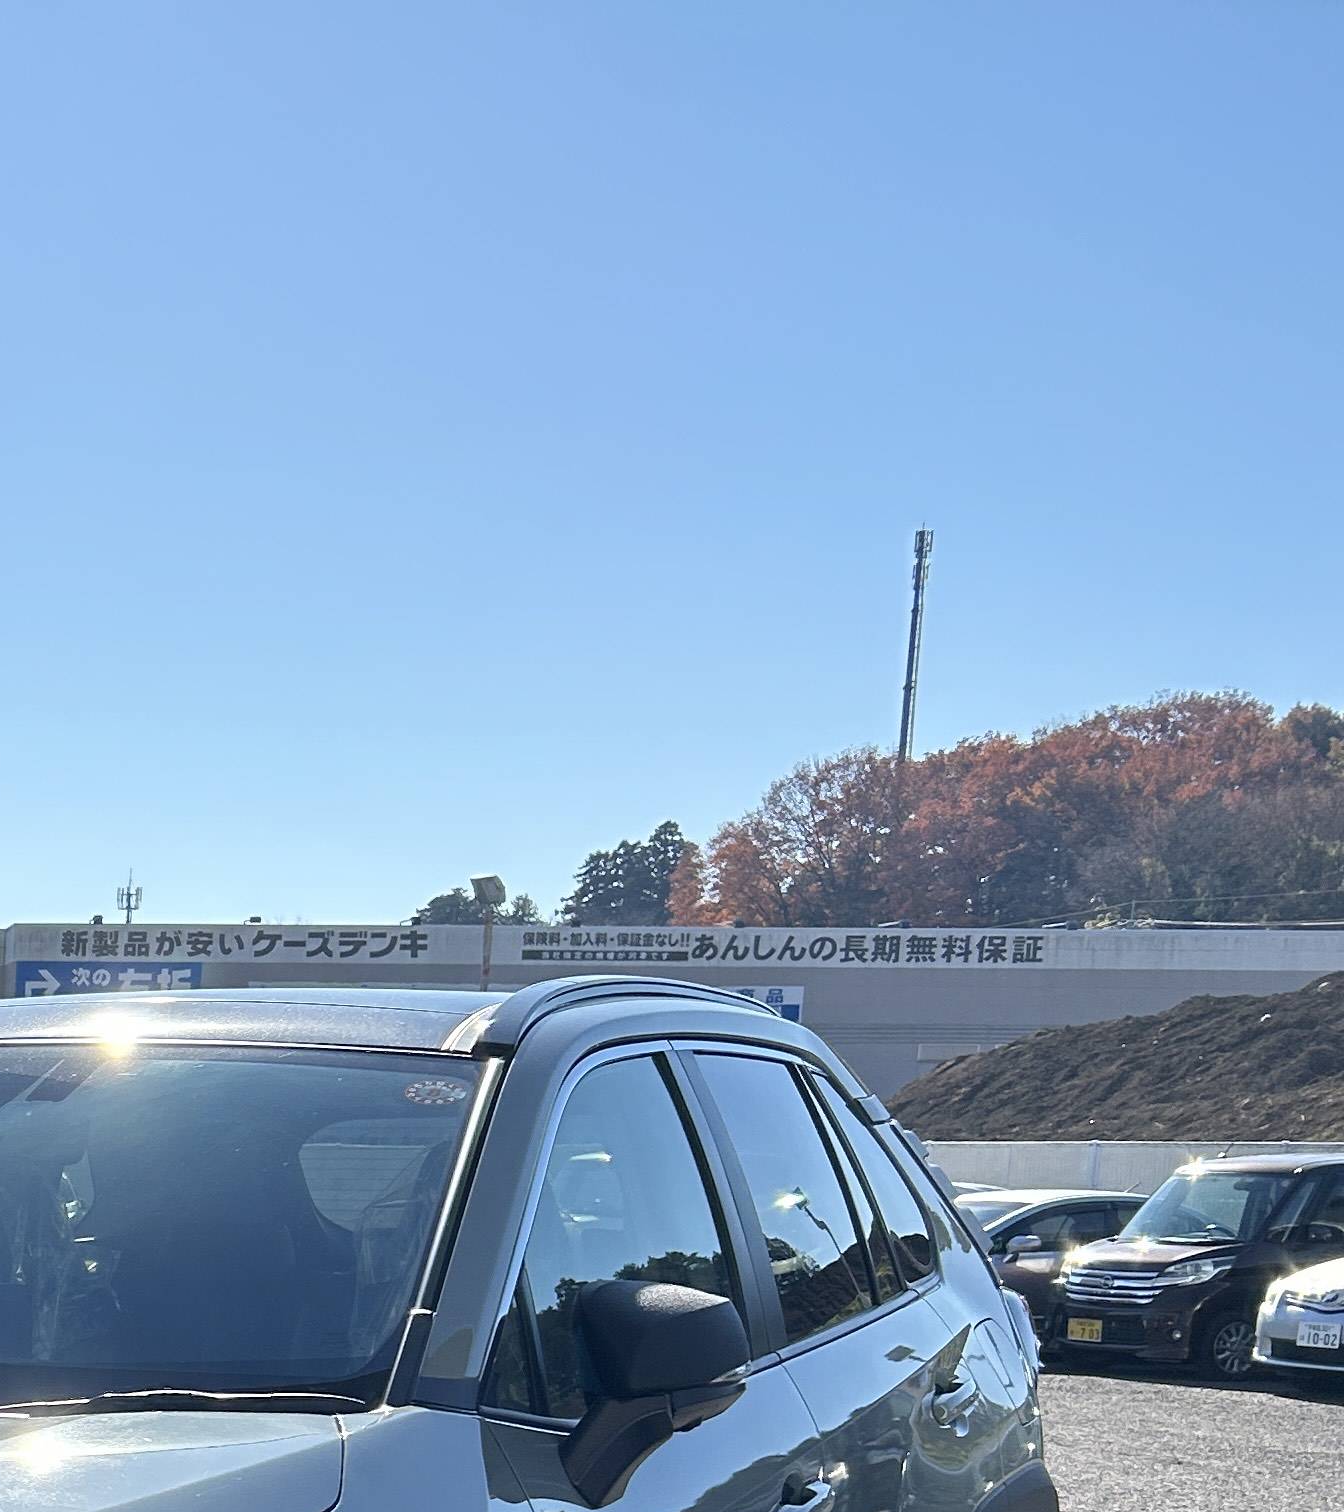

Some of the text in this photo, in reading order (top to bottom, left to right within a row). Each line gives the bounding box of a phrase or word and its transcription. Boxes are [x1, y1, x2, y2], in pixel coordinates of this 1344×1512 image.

[62, 930, 428, 958] 新製品が安いケーズデンキ
[692, 935, 1044, 964] あんしんの長期無料保証
